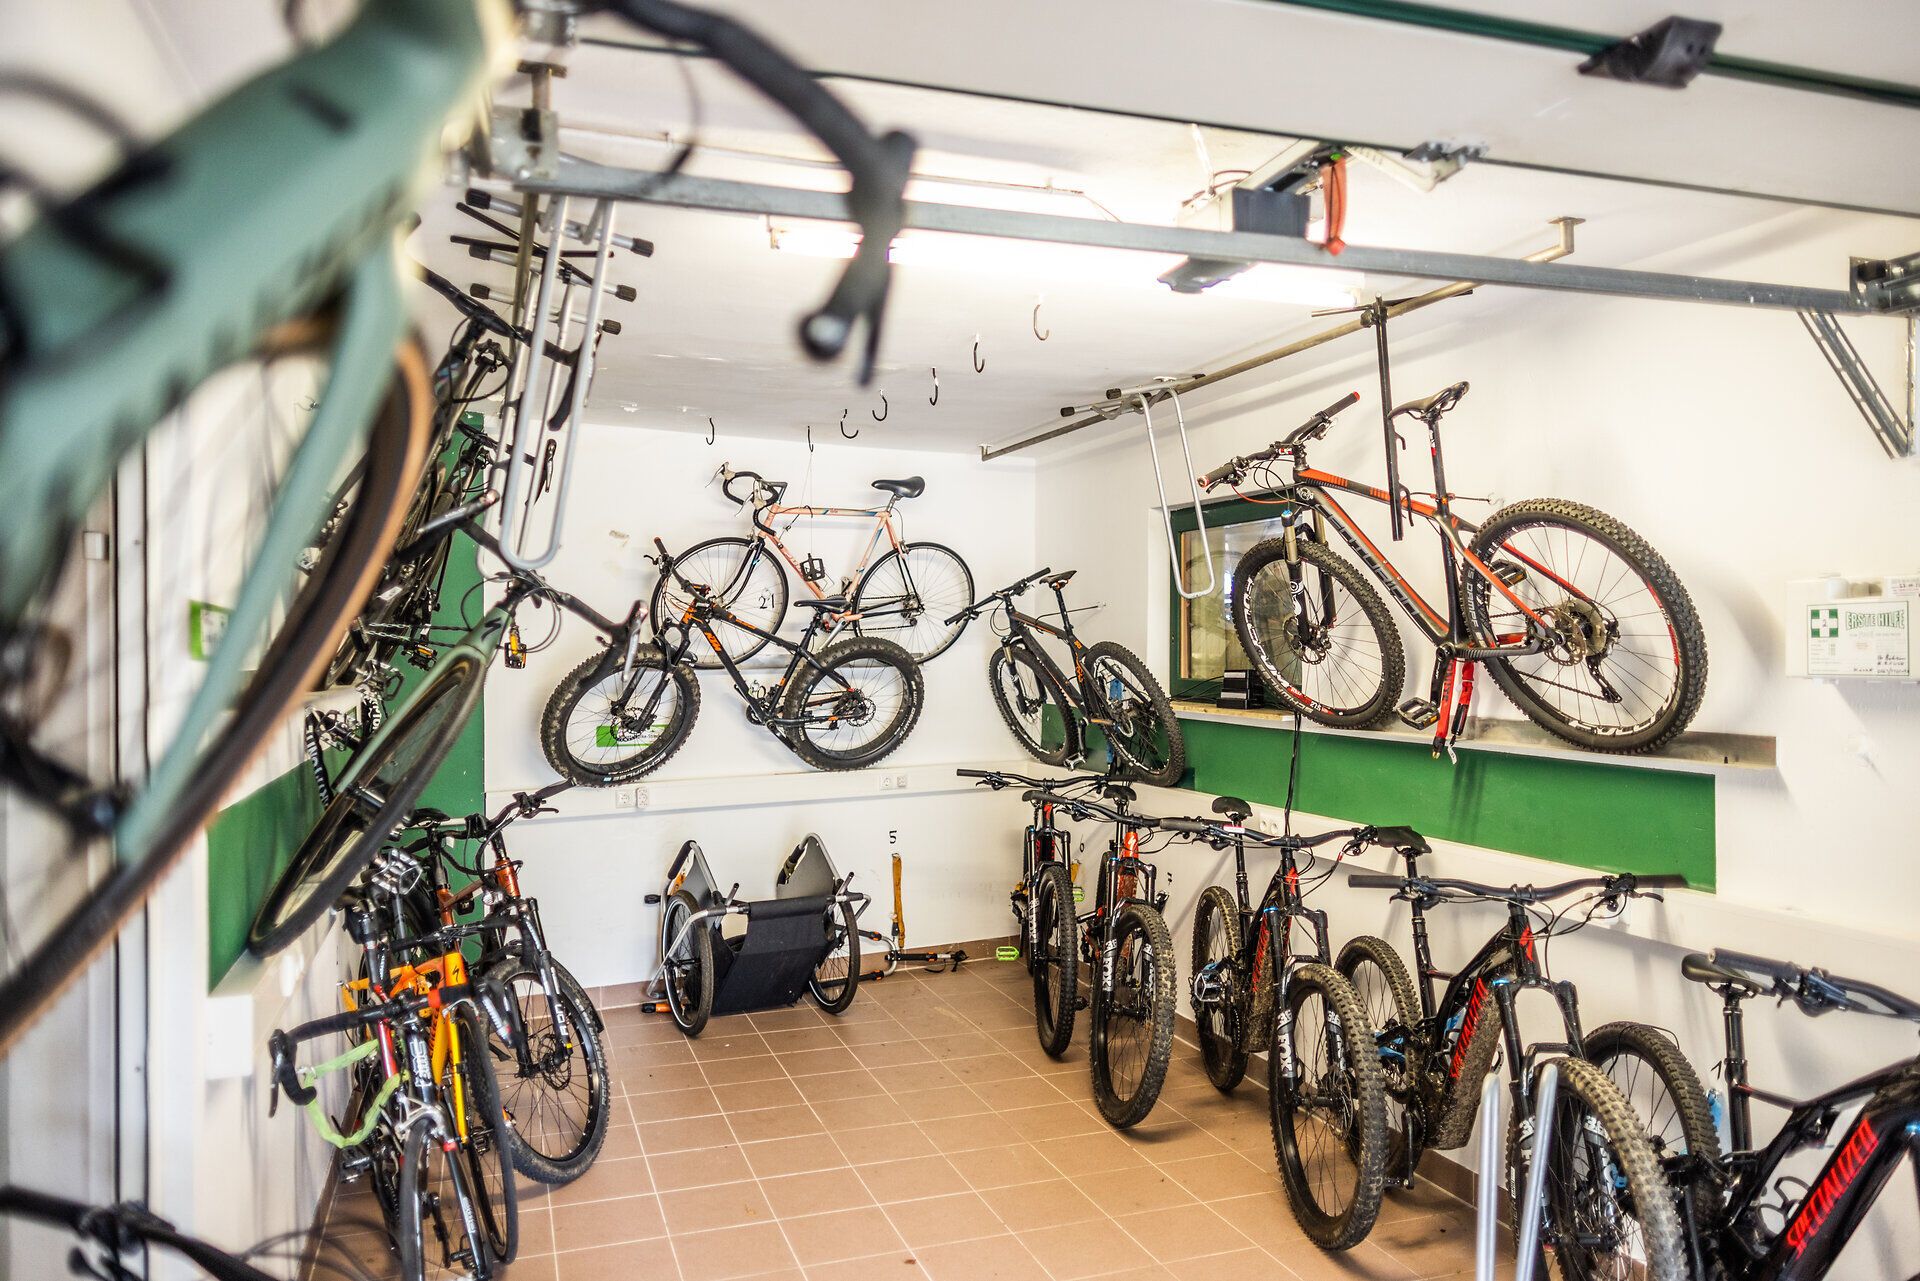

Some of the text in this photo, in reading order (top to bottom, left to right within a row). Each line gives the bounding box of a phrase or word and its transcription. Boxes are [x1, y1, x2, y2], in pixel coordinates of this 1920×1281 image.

[758, 594, 775, 609] 21
[1845, 609, 1905, 630] ERSTE HILFE
[889, 830, 898, 844] 5
[1277, 1033, 1293, 1077] FOX
[1786, 1116, 1879, 1260] SPECIALIZED
